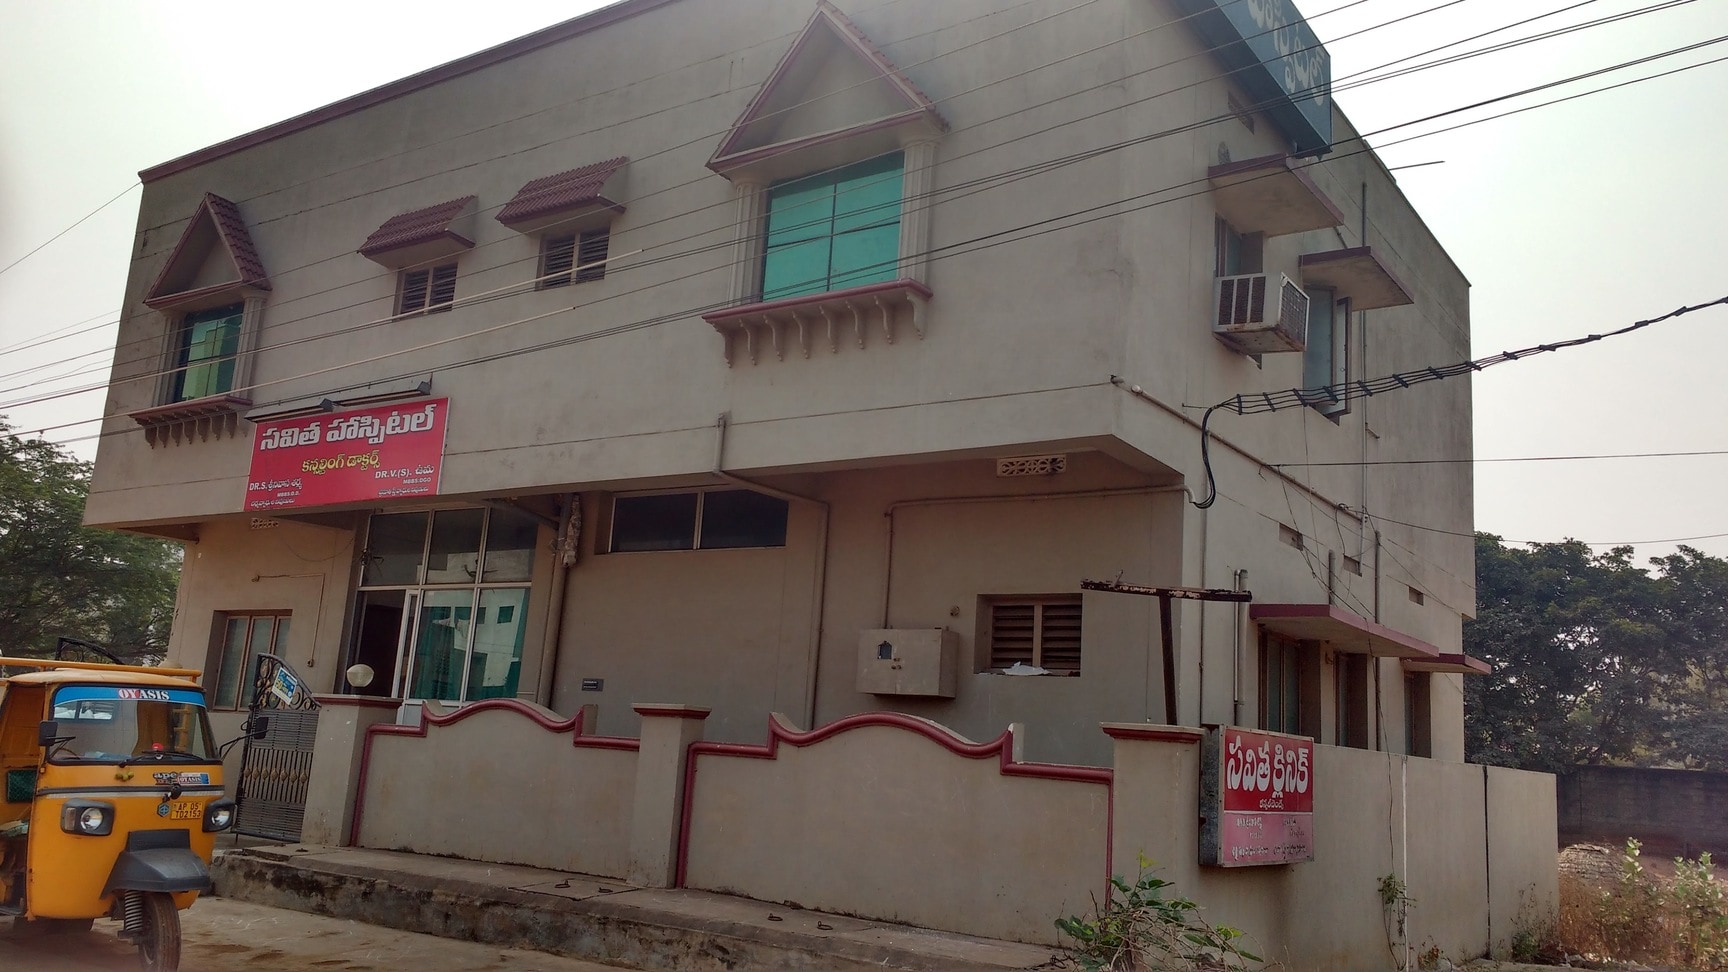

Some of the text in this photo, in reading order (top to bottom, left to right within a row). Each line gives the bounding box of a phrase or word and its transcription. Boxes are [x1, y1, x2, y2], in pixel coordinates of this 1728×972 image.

[260, 404, 438, 450] సవిత హాస్పిటల్
[118, 689, 170, 701] OYASIS
[1226, 735, 1309, 798] సవిత క్లినిక్
